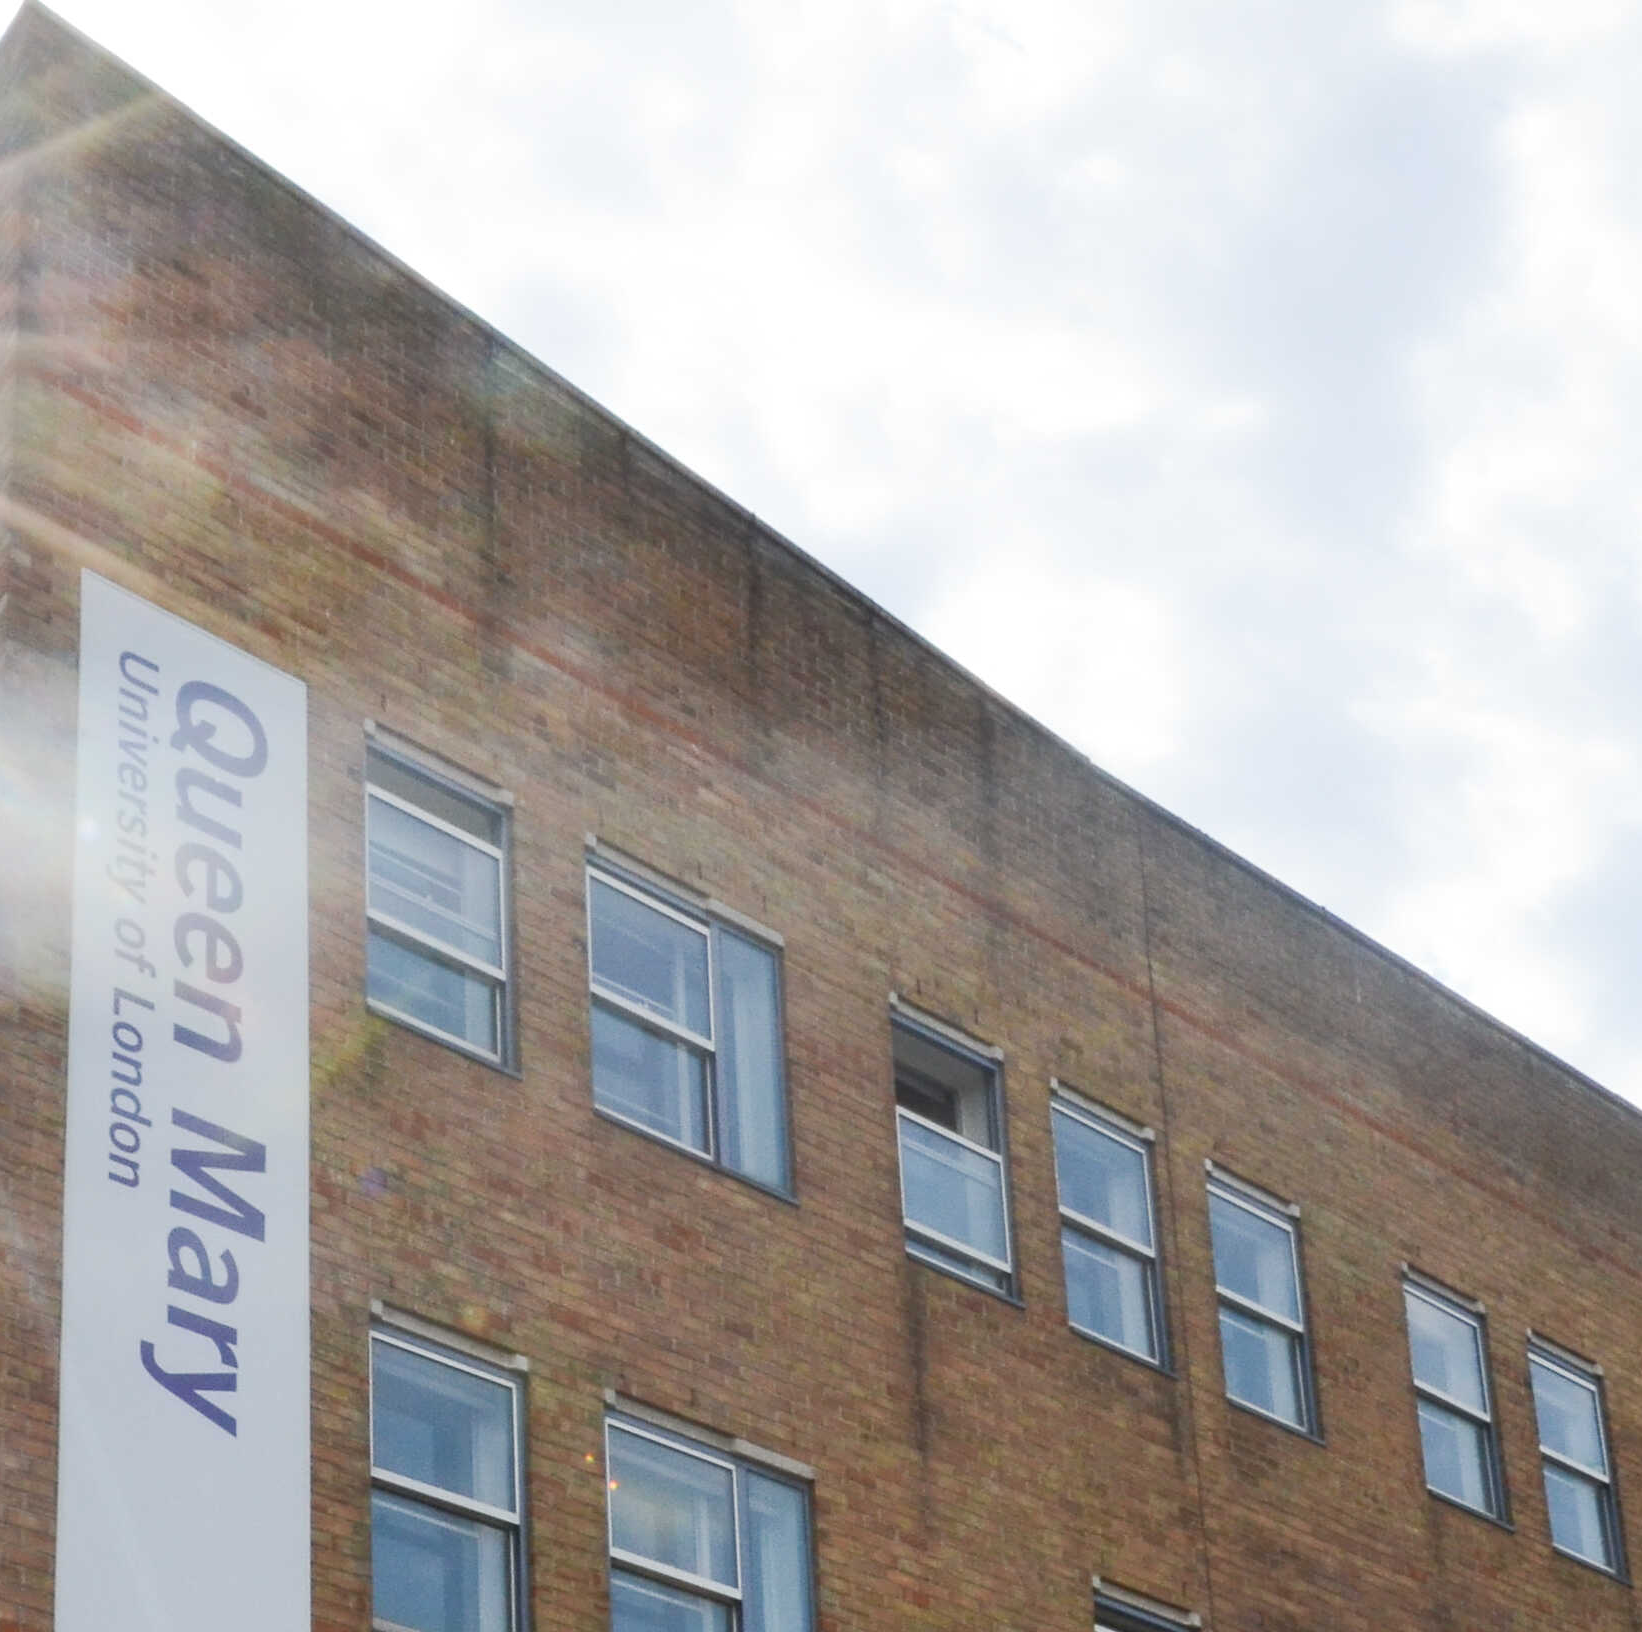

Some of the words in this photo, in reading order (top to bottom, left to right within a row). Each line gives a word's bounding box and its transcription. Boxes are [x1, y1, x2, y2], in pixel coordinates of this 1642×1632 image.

[104, 650, 160, 900] University
[172, 679, 268, 1064] Queen
[113, 915, 156, 979] of
[107, 993, 154, 1189] London
[140, 1112, 267, 1436] Mary
